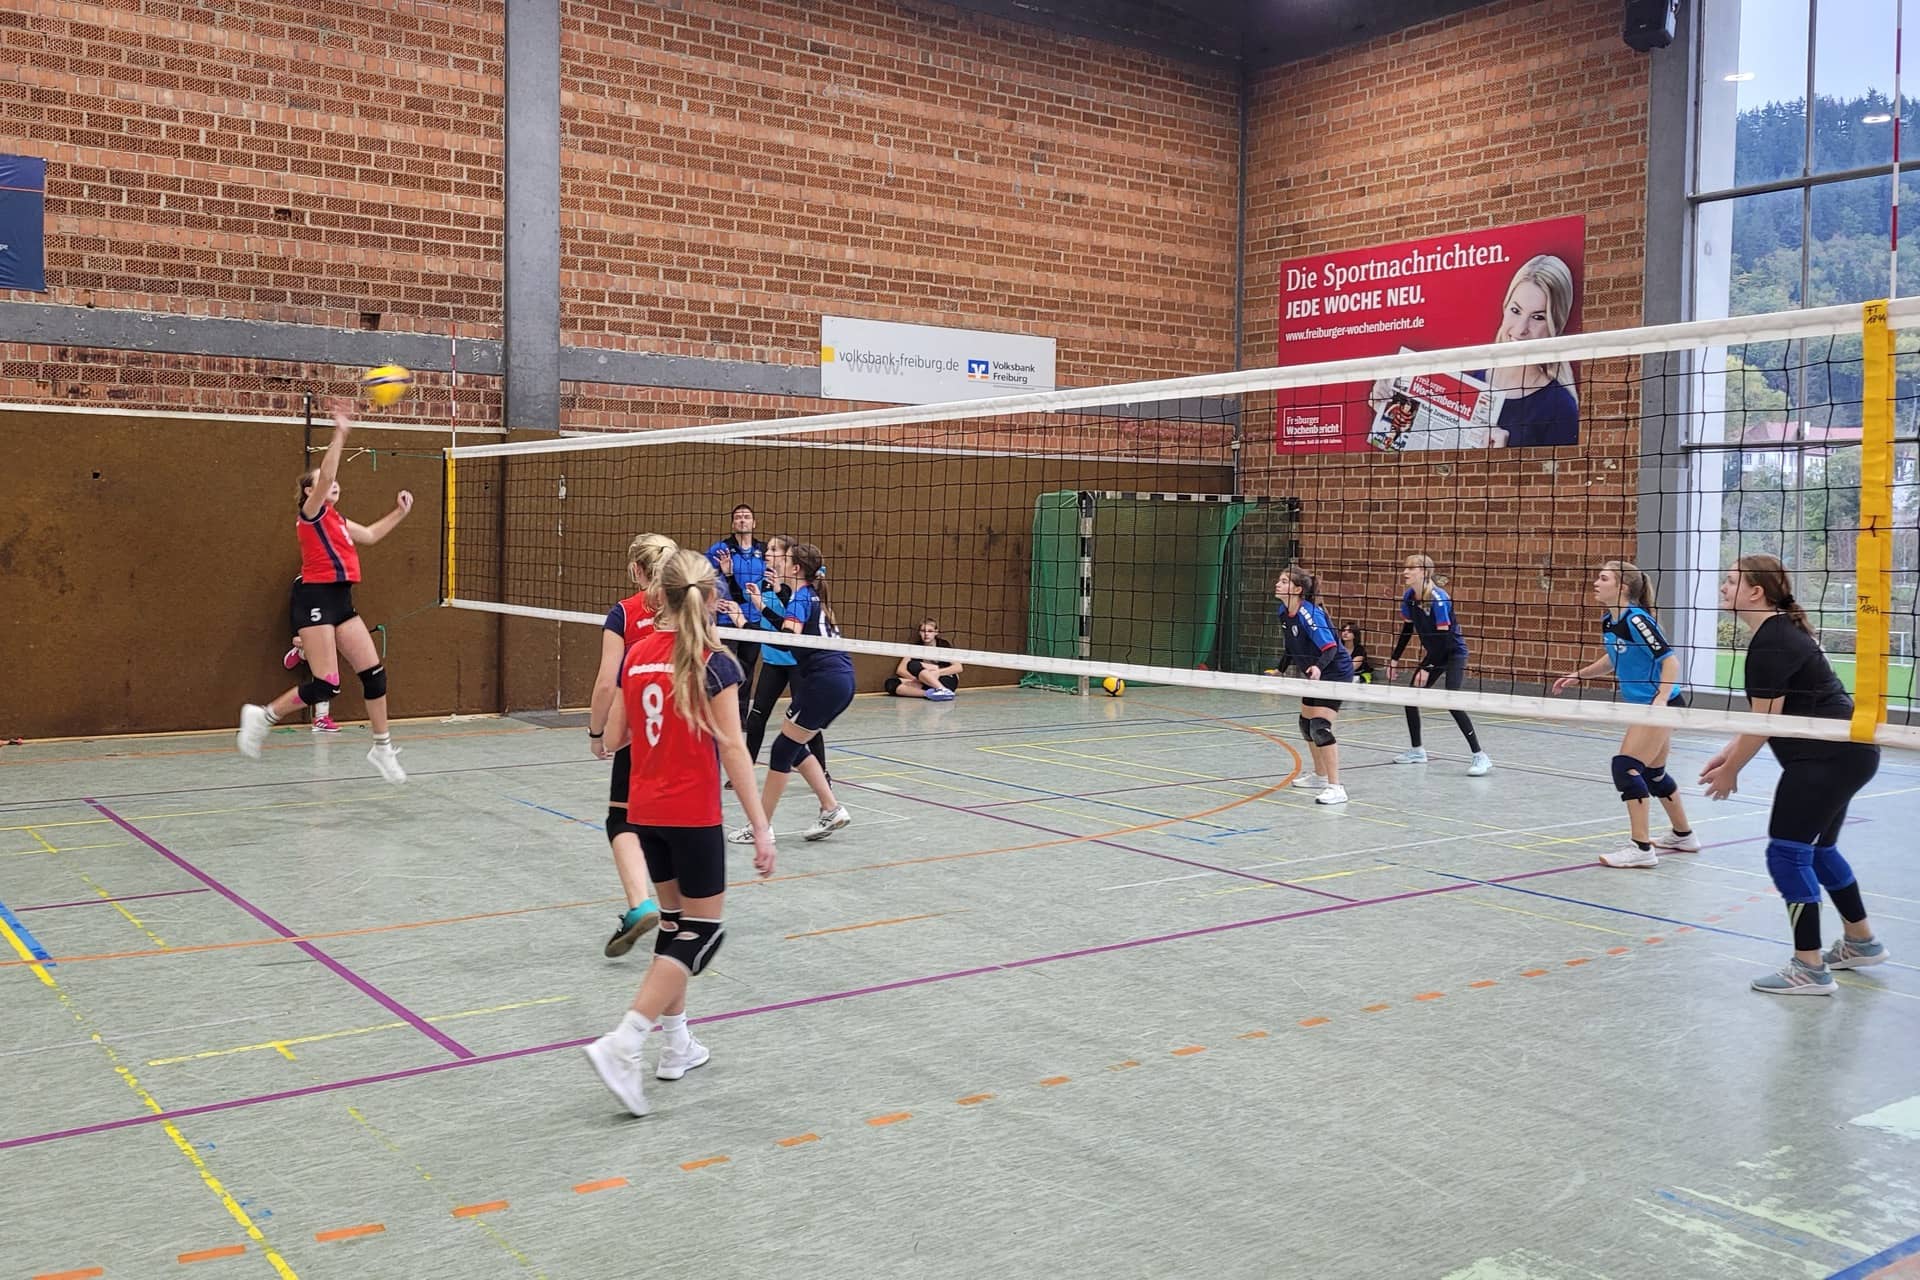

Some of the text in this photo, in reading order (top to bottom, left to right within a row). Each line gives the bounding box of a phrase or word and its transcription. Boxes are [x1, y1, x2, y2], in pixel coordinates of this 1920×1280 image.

[1286, 243, 1511, 292] Die Sportnachrichten.
[1286, 285, 1426, 320] JEDE WOCHE NEU.
[1285, 316, 1425, 342] www.freiburger-wochenbericht.de
[838, 349, 960, 373] volksbank-freiburg.de
[992, 360, 1036, 373] Volksbank
[992, 372, 1029, 384] Freiburg
[310, 607, 322, 622] 5
[641, 682, 664, 748] 8
